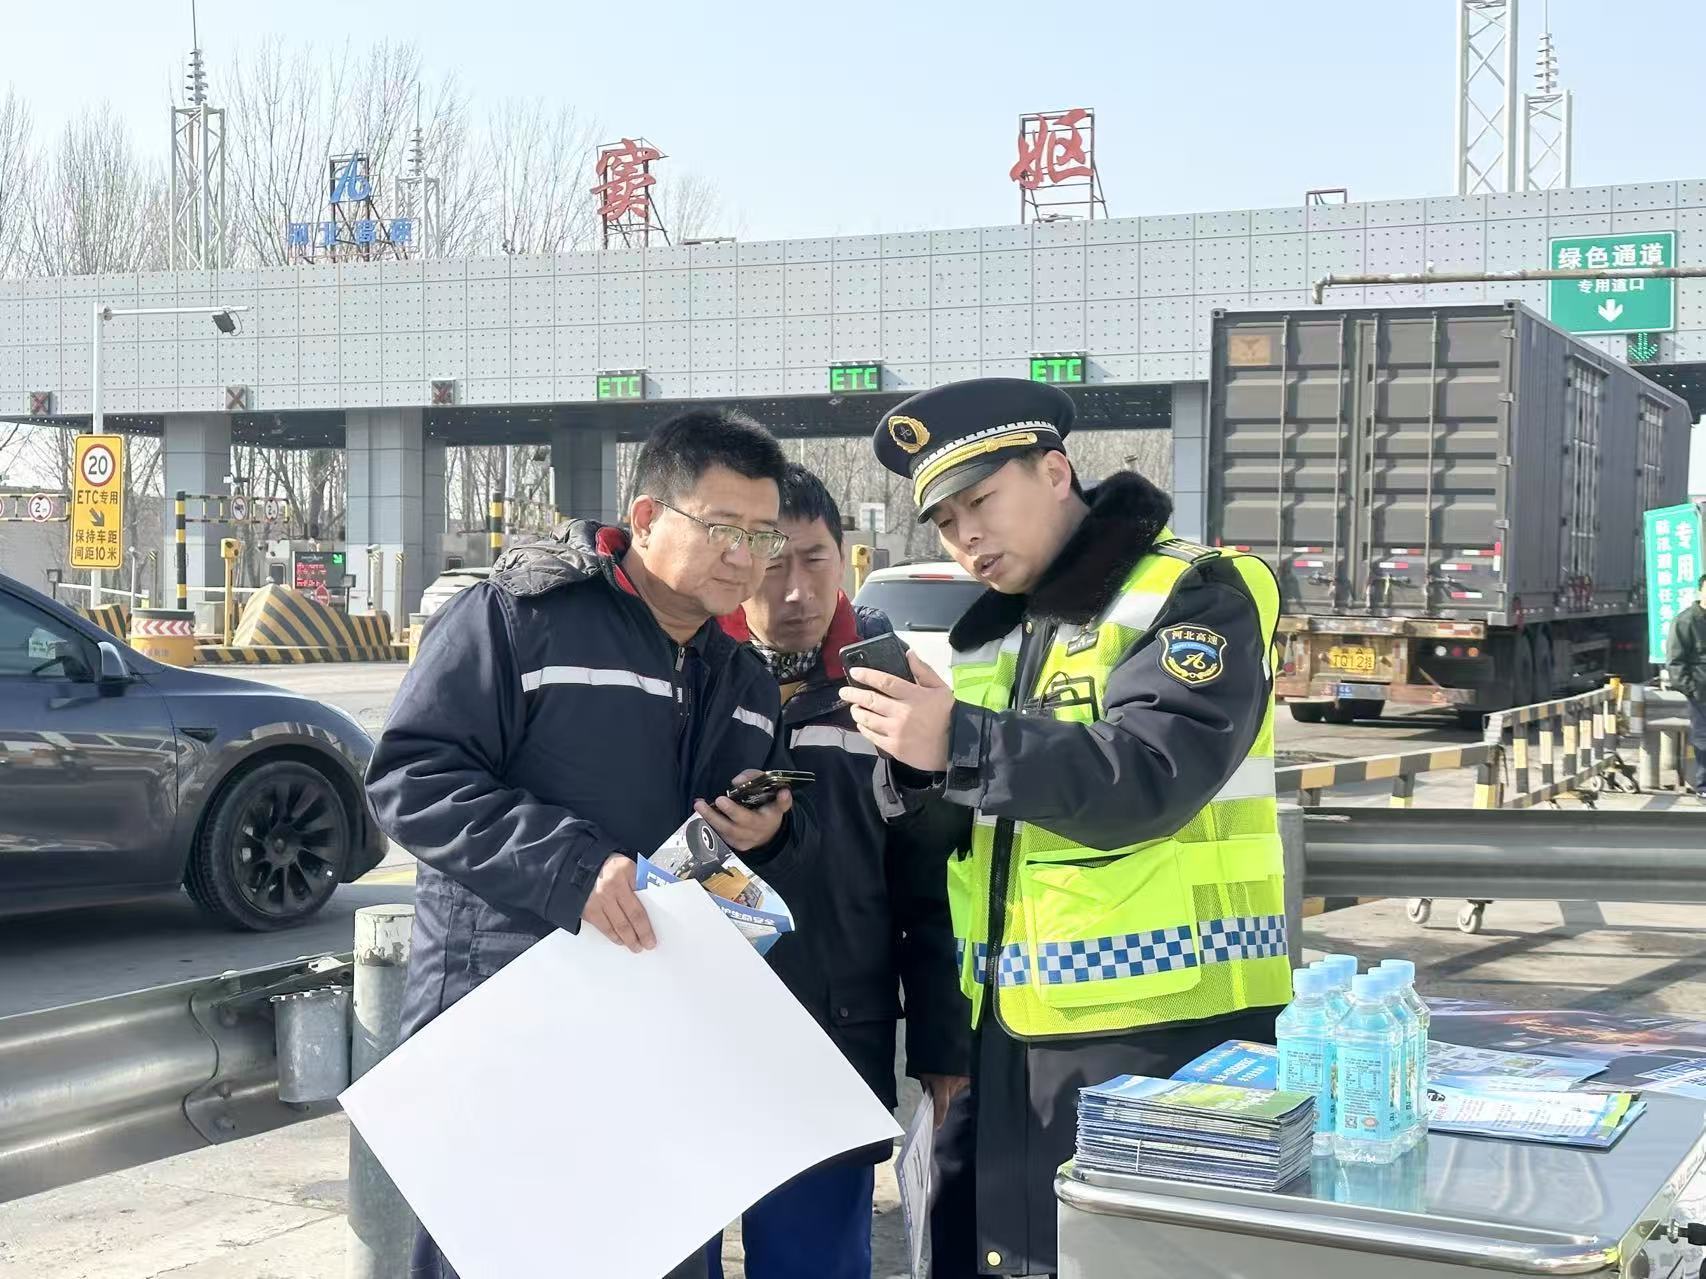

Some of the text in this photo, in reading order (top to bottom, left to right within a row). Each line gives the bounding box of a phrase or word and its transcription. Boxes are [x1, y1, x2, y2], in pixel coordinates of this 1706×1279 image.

[1558, 243, 1664, 269] 绿色通道
[1577, 278, 1645, 293] 专用道口
[1032, 358, 1082, 382] ETC
[599, 376, 641, 398] ETC
[832, 367, 878, 391] ETC
[88, 455, 108, 475] 20
[77, 490, 118, 504] ETC专用
[75, 530, 117, 543] 保持车距
[74, 546, 117, 560] 间距10米
[1172, 630, 1218, 645] 河北高速
